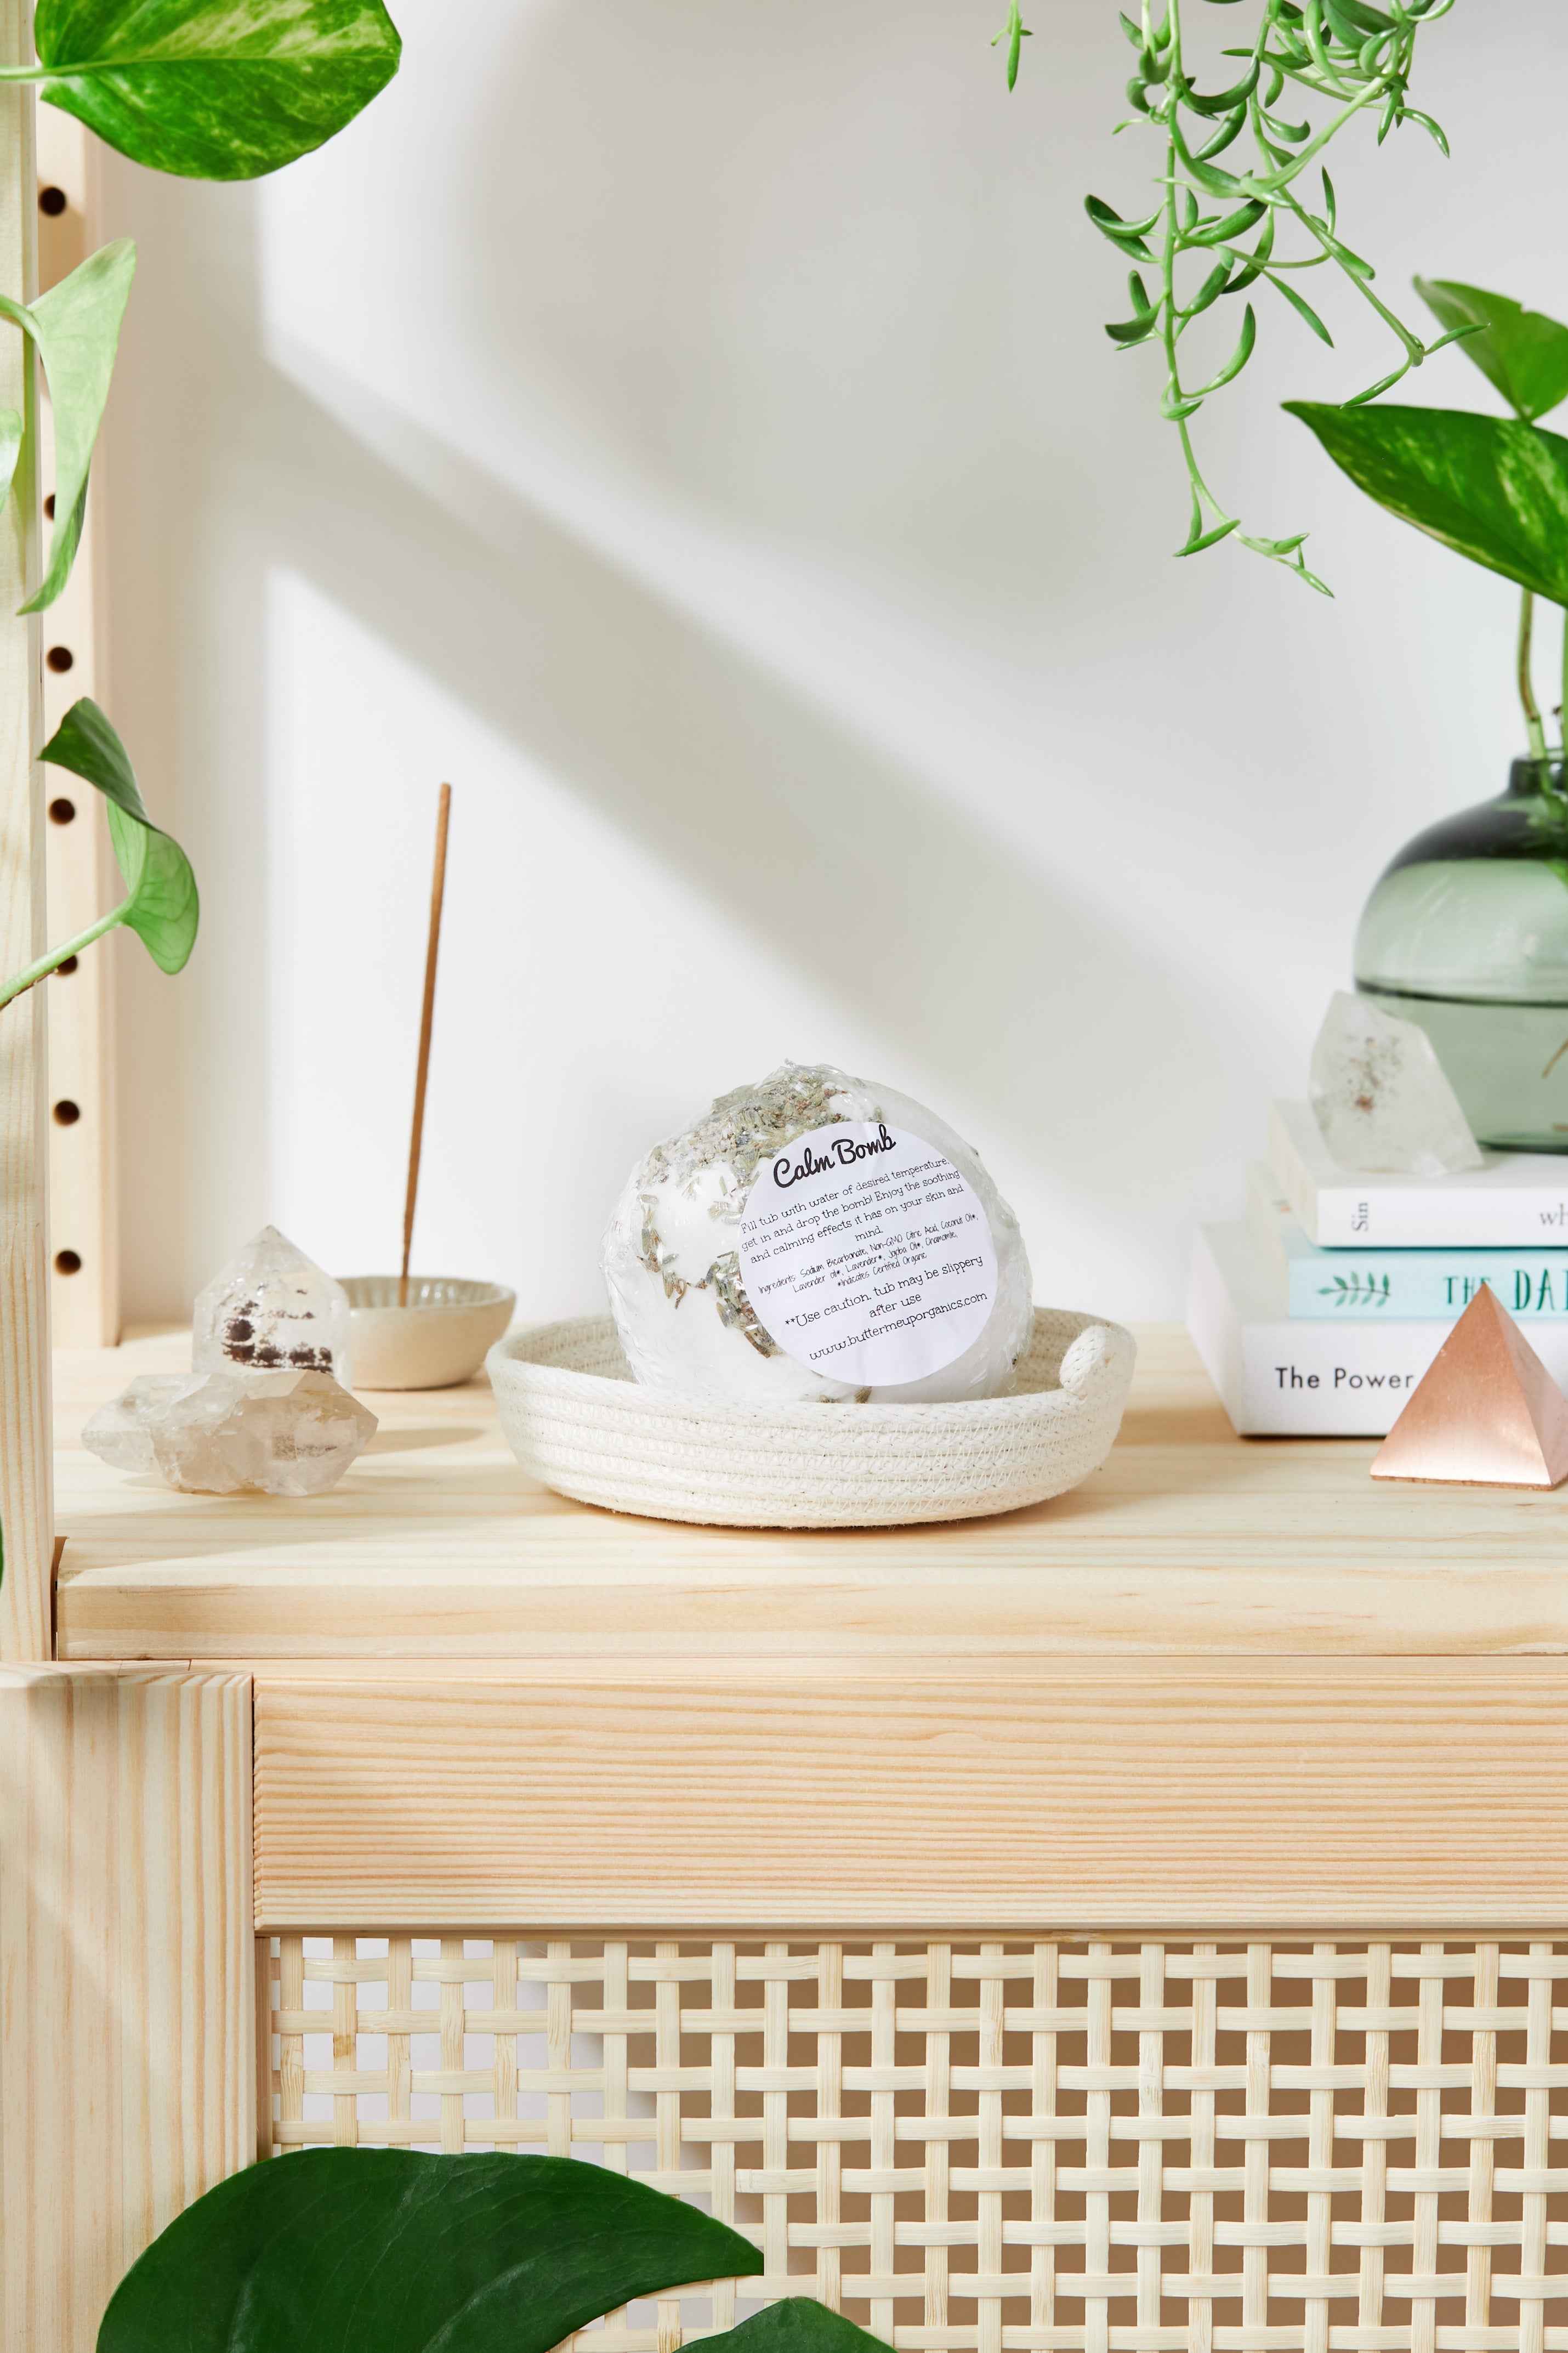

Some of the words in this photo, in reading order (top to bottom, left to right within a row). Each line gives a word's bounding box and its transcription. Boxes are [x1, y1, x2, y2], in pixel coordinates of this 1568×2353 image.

[773, 1148, 836, 1188] Calm
[831, 1124, 896, 1164] Bomb
[741, 1221, 757, 1234] Fill
[759, 1214, 779, 1227] tub
[781, 1203, 806, 1217] with
[808, 1193, 839, 1207] water
[842, 1185, 853, 1196] of
[856, 1173, 890, 1190] desired
[742, 1237, 758, 1252] get
[760, 1234, 771, 1243] in
[774, 1223, 794, 1237] and
[797, 1215, 820, 1228] drop
[821, 1207, 839, 1218] the
[874, 1187, 904, 1202] Enjoy
[904, 1180, 921, 1193] the
[921, 1170, 959, 1187] soothing
[751, 1249, 771, 1263] and
[774, 1233, 815, 1255] calming
[817, 1220, 852, 1237] effects
[854, 1215, 862, 1224] it
[863, 1211, 882, 1221] has
[900, 1198, 922, 1211] your
[925, 1189, 946, 1201] skin
[947, 1184, 964, 1195] and
[1351, 1202, 1369, 1232] Sin
[793, 1275, 825, 1293] Lavender
[887, 1246, 907, 1259] Jojoba
[800, 1265, 825, 1278] Sodium
[868, 1234, 904, 1251] Non-GMO
[940, 1216, 963, 1229] Coconut
[873, 1258, 901, 1275] Certified
[873, 1283, 895, 1296] tub
[897, 1275, 924, 1290] may
[924, 1269, 939, 1280] be
[942, 1256, 982, 1274] slippery
[1444, 1276, 1491, 1305] TH
[809, 1294, 987, 1359] www.buttermeuporganics.com
[870, 1303, 897, 1319] after
[900, 1294, 922, 1307] use
[1275, 1366, 1320, 1388] The
[1334, 1368, 1414, 1388] Power
